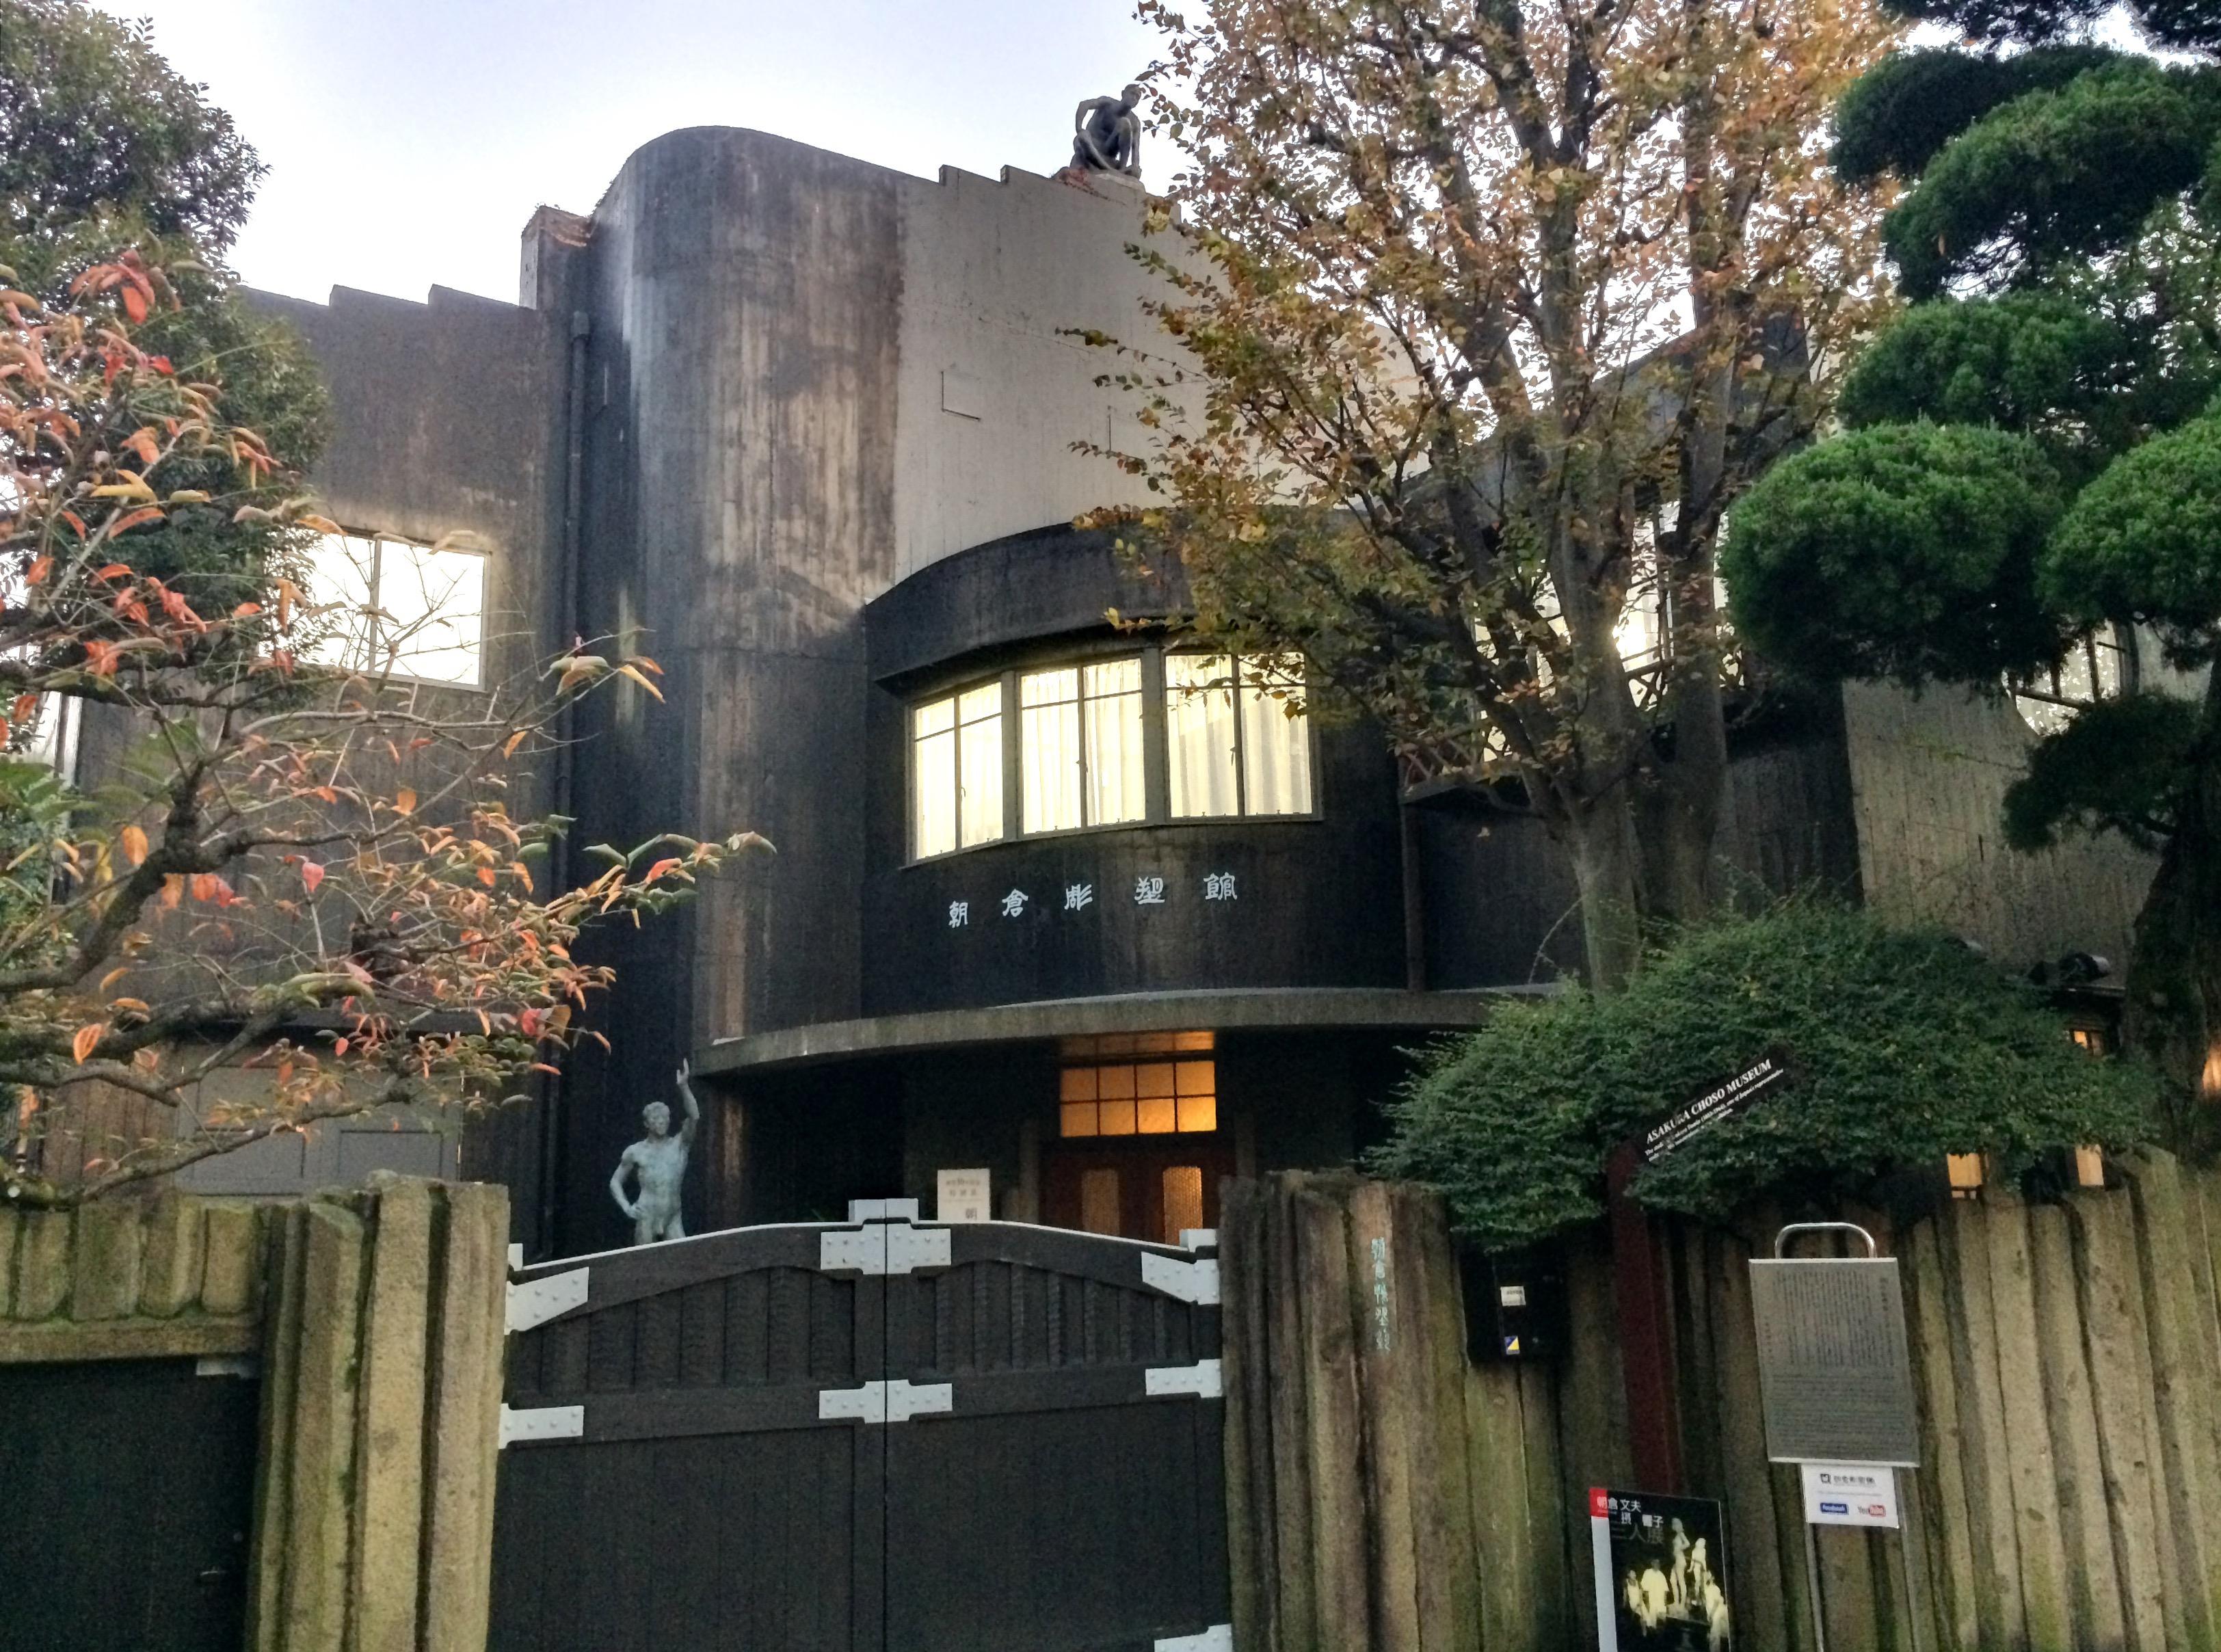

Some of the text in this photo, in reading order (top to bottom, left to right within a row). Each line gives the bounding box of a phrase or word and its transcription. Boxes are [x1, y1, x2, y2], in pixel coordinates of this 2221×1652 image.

[948, 871, 1238, 929] 朝倉彫塑館
[1690, 1088, 1725, 1115] CHOSO
[1725, 1058, 1772, 1094] MUSEUM
